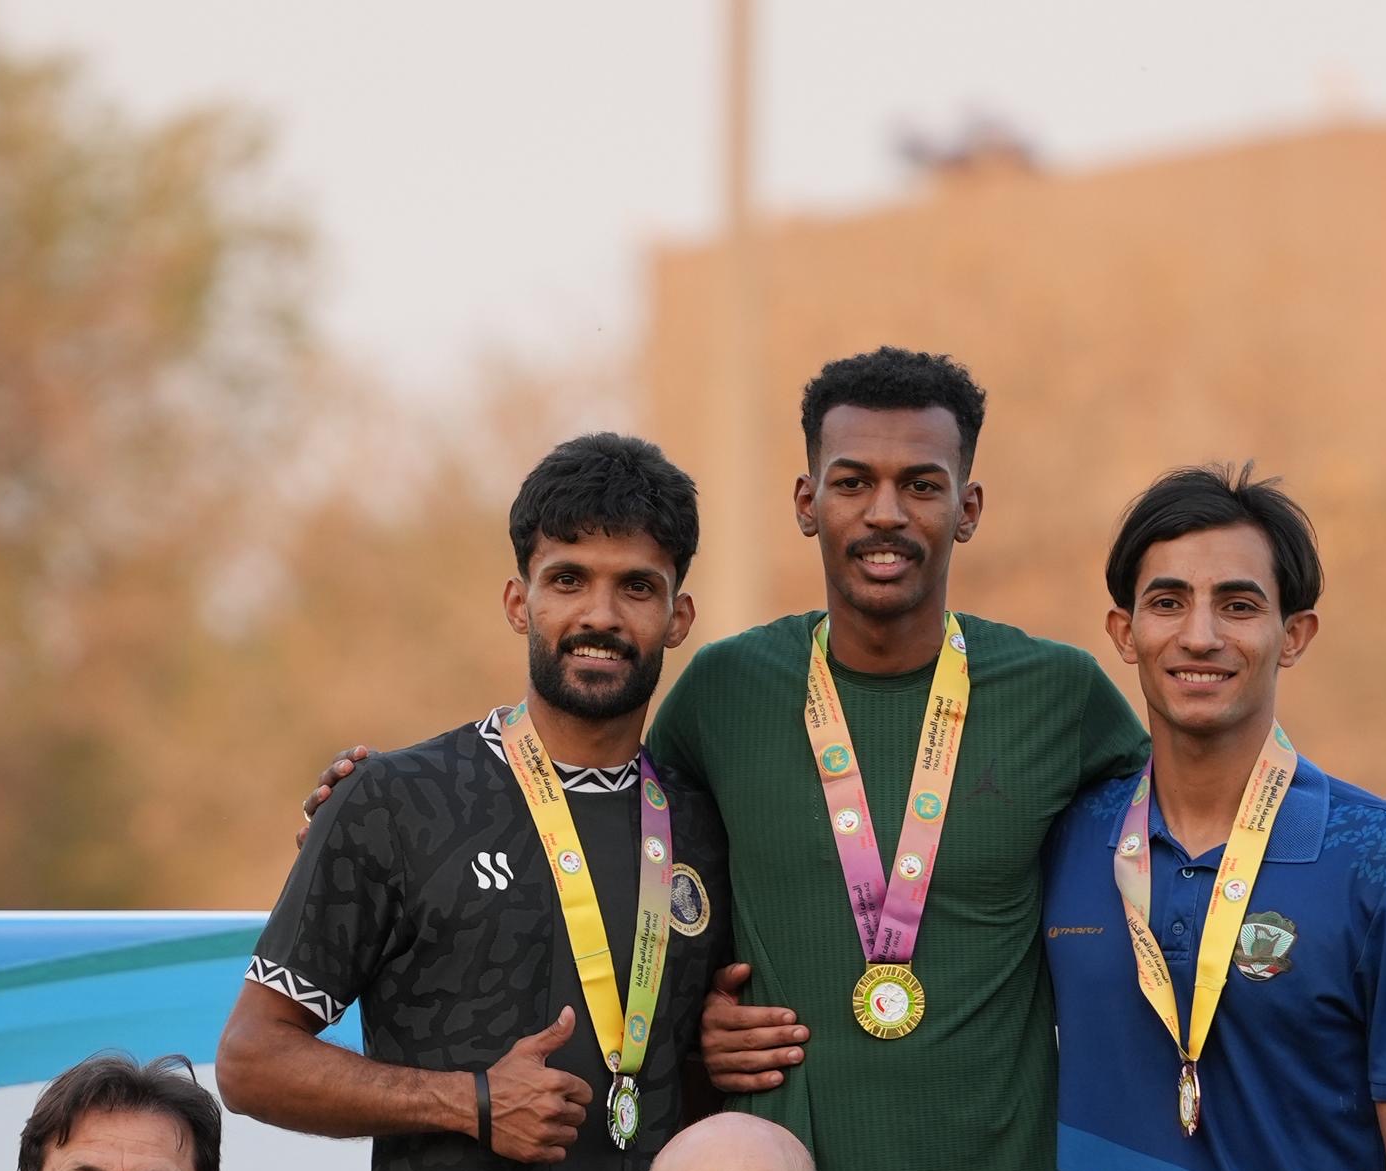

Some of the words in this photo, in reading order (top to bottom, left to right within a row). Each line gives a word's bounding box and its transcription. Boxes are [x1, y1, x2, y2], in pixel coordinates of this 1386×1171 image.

[933, 749, 943, 771] TRADE
[938, 730, 946, 749] BANK
[944, 698, 954, 716] IRAQ
[517, 739, 527, 759] TRADE
[538, 787, 549, 804] IRAQ
[1152, 968, 1164, 987] IRAQ
